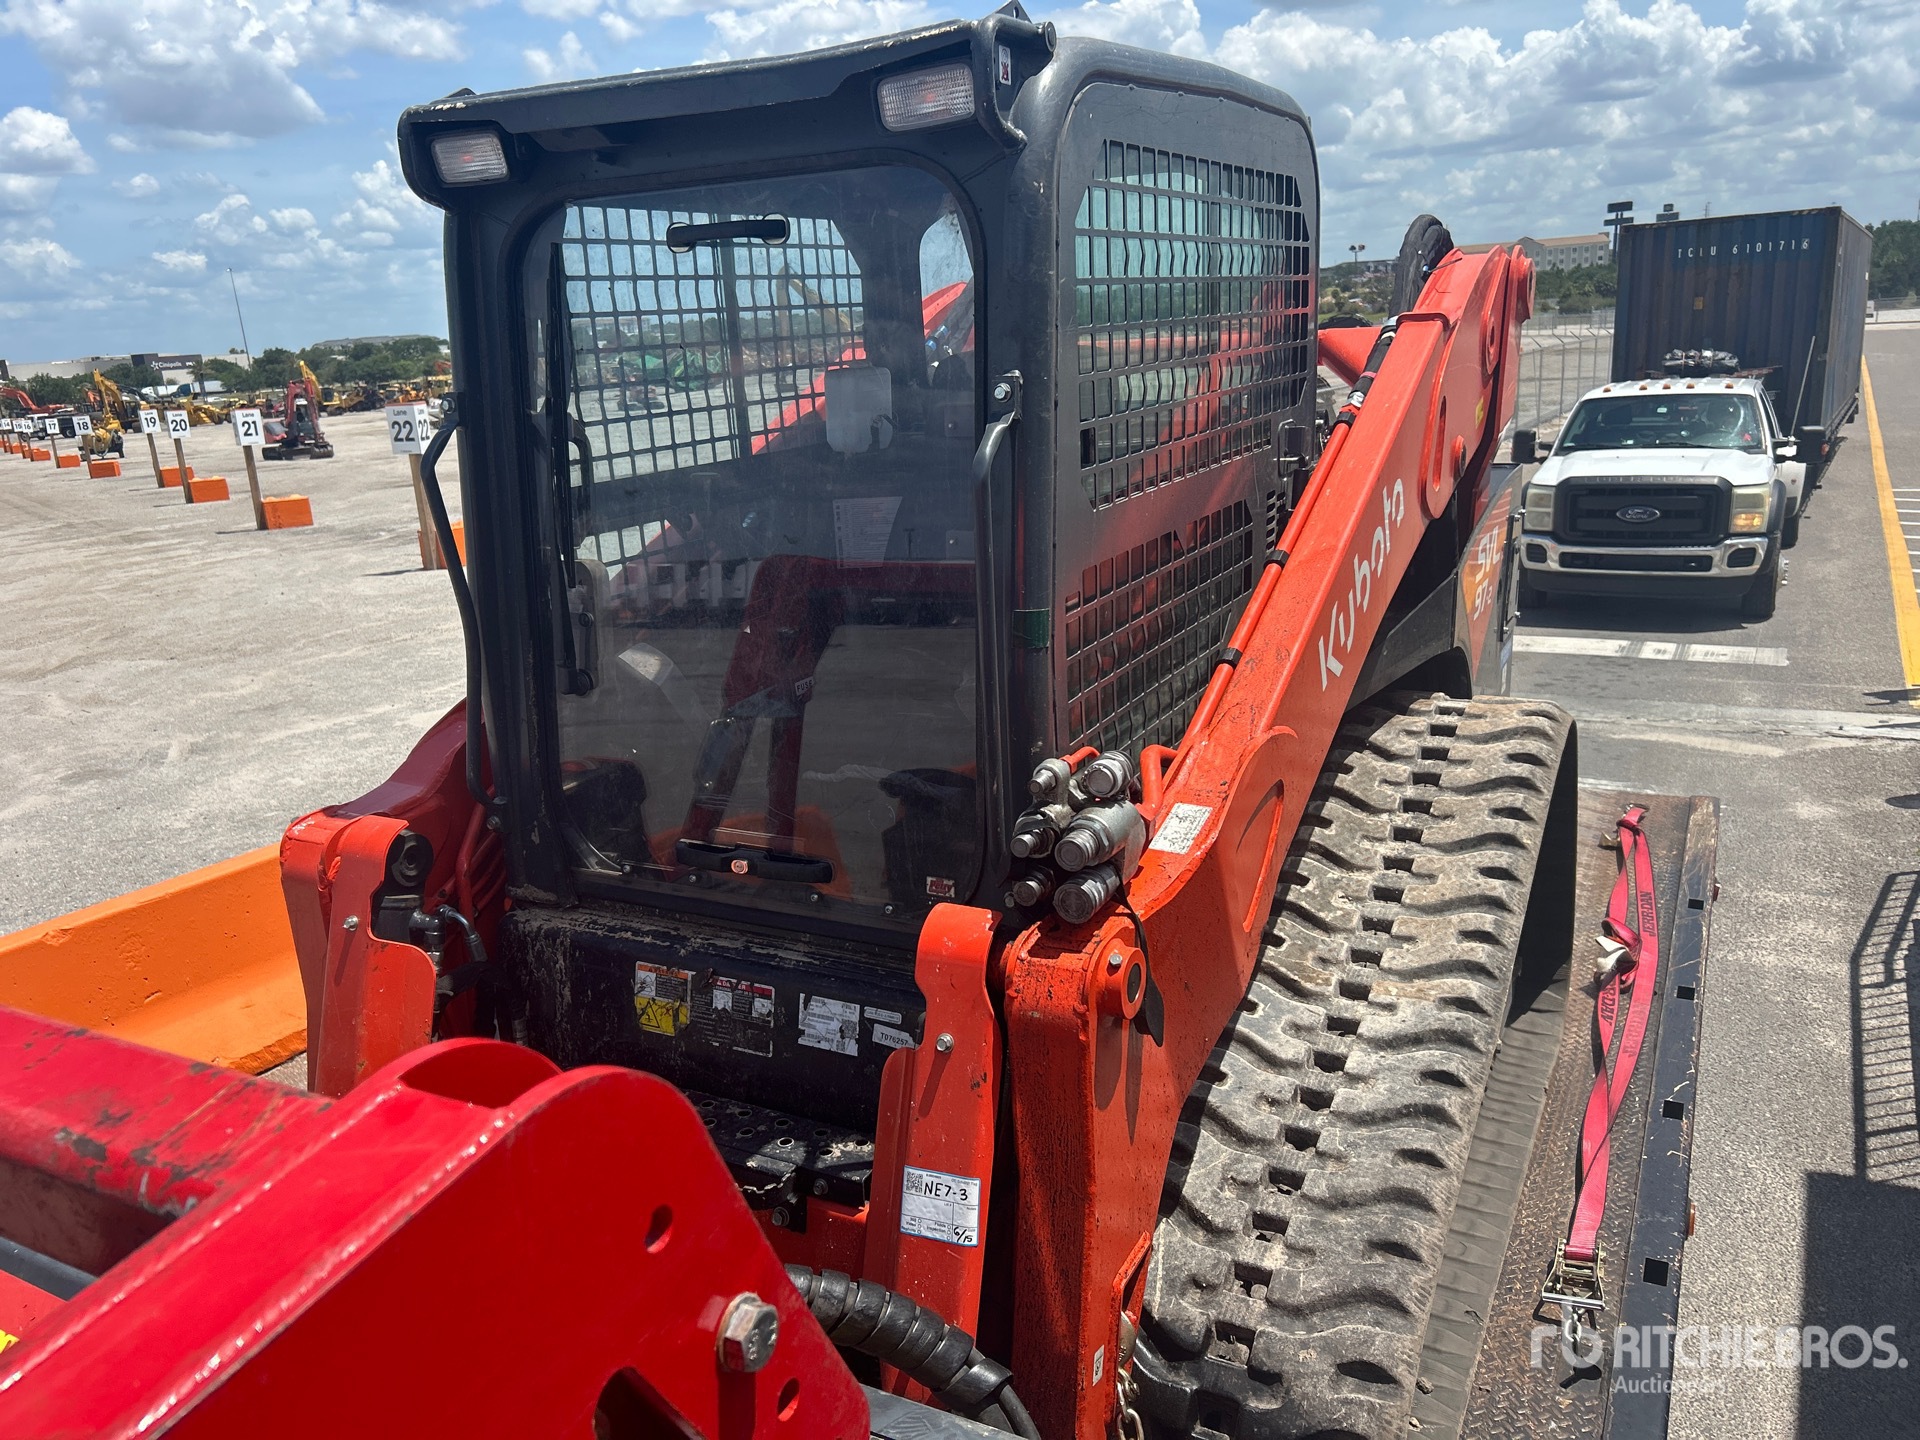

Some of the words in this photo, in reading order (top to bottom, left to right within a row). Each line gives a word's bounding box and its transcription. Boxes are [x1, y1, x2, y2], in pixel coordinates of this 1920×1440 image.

[1732, 239, 1810, 255] 6101716
[48, 422, 57, 430] 17
[76, 421, 89, 431] 18
[144, 416, 157, 428] 19
[170, 418, 188, 432] 20
[241, 420, 259, 437] 21
[418, 418, 431, 441] 22
[391, 420, 416, 442] 22
[1624, 508, 1652, 519] Ford
[1475, 525, 1501, 584] SVL
[1318, 478, 1405, 692] Kubota
[880, 1032, 909, 1046] T076257
[924, 1180, 968, 1201] NE7-3
[953, 1226, 974, 1243] 6/15
